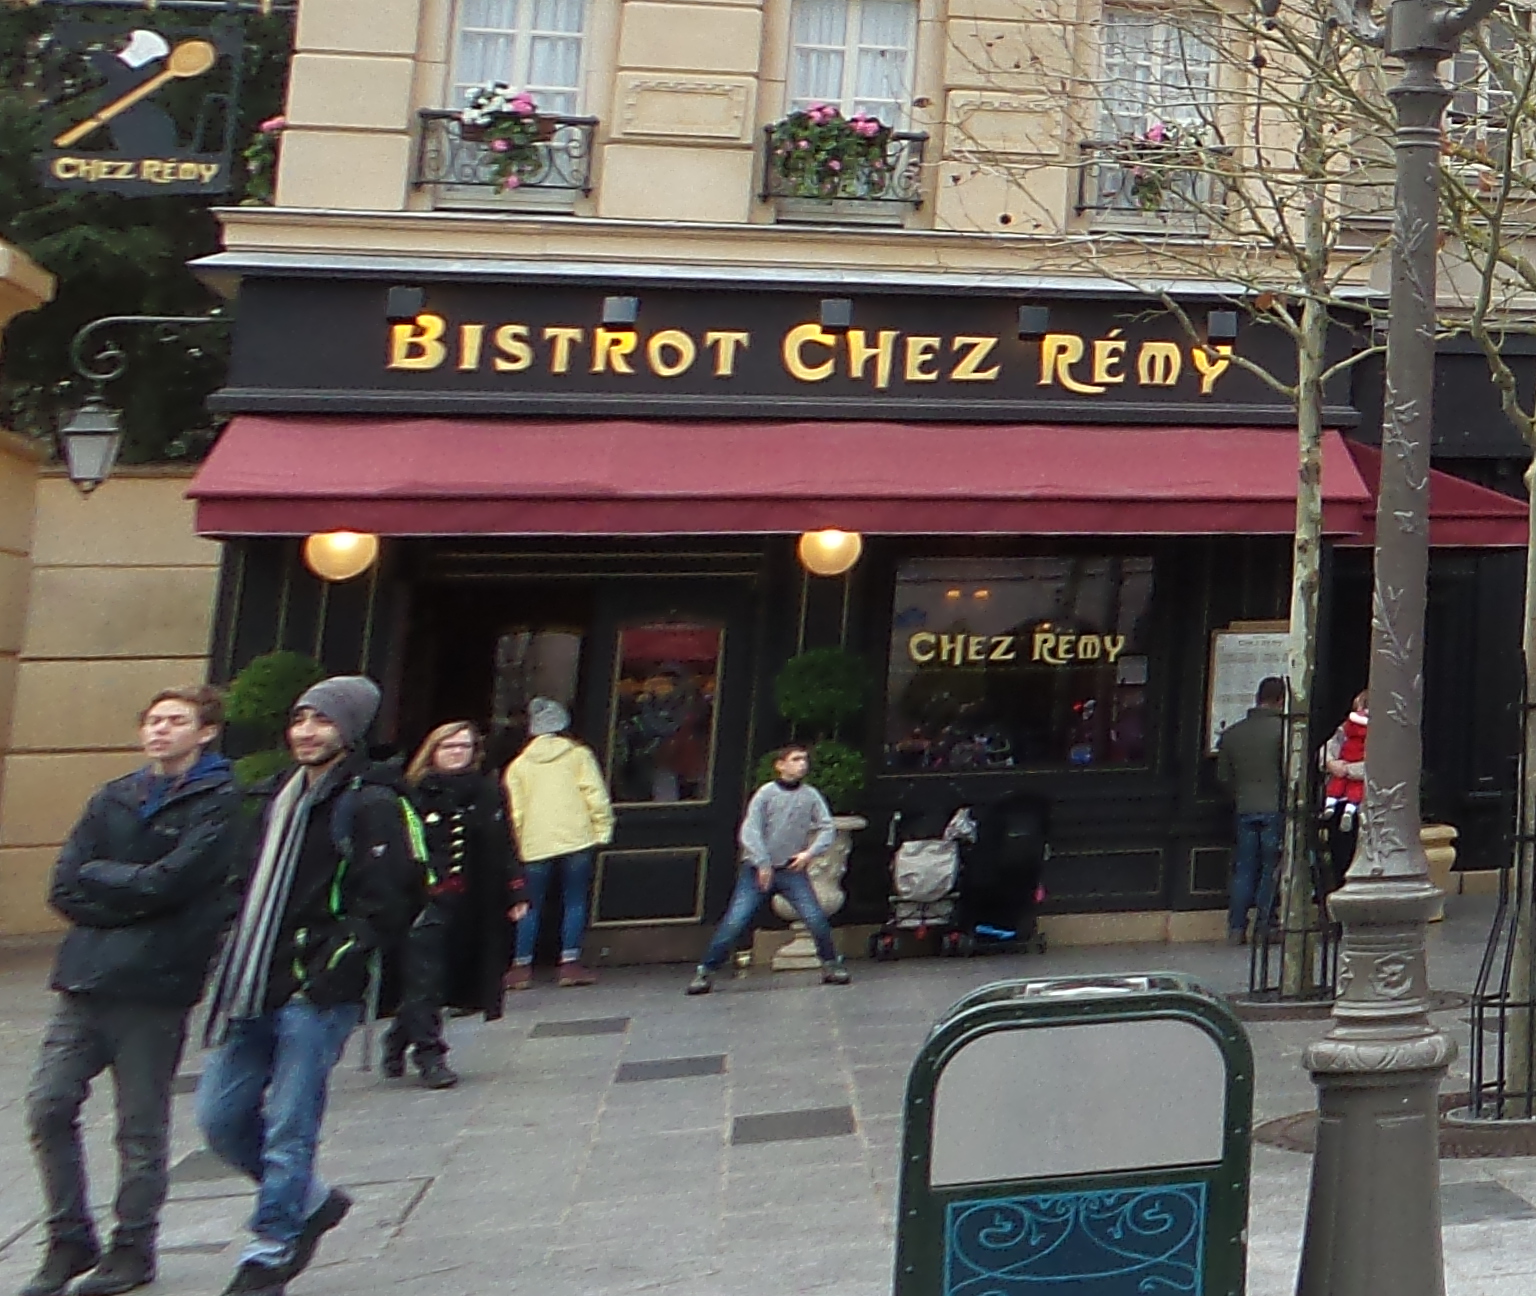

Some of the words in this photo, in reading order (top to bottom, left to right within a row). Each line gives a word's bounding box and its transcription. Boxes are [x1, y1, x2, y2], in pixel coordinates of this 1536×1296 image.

[54, 157, 136, 182] CHEZ
[387, 313, 750, 379] BISTROT
[783, 324, 1000, 388] CHEZ
[1037, 328, 1231, 393] RÉMY
[909, 631, 1016, 666] CHEZ
